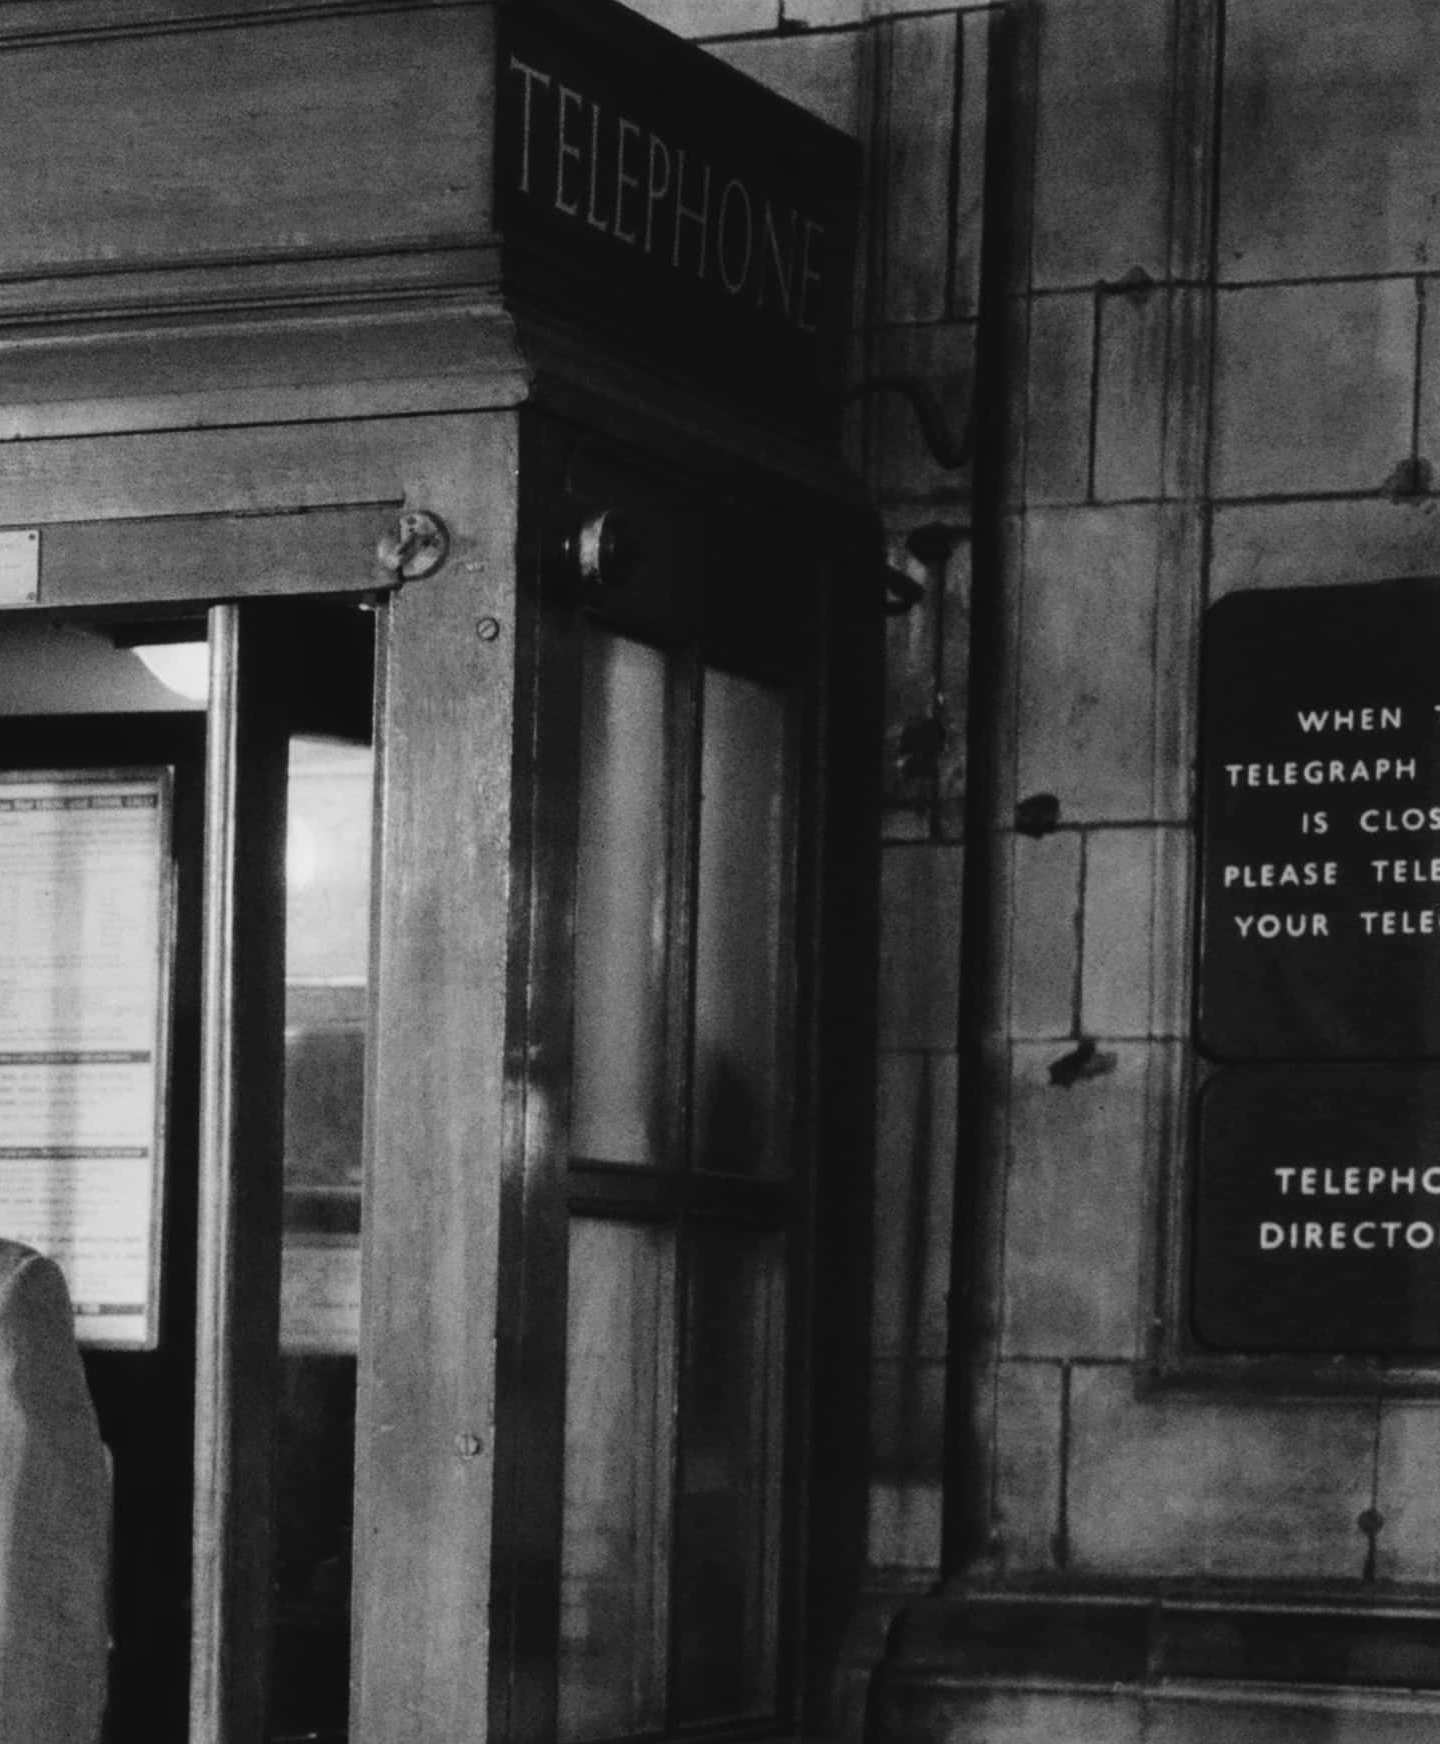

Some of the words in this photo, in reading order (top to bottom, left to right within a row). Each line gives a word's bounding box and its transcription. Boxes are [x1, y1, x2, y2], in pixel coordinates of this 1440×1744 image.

[509, 54, 825, 333] TELEPHONE
[1298, 707, 1401, 732] WHEN
[1225, 758, 1415, 786] TELEGRAPH
[1302, 811, 1328, 834] IS
[1224, 862, 1337, 888] PLEASE
[1371, 858, 1440, 882] TELE
[1234, 913, 1329, 938] YOUR
[1359, 910, 1440, 935] TELE
[1275, 1166, 1440, 1195] TELEPHO
[1259, 1220, 1440, 1250] DIRECTO
